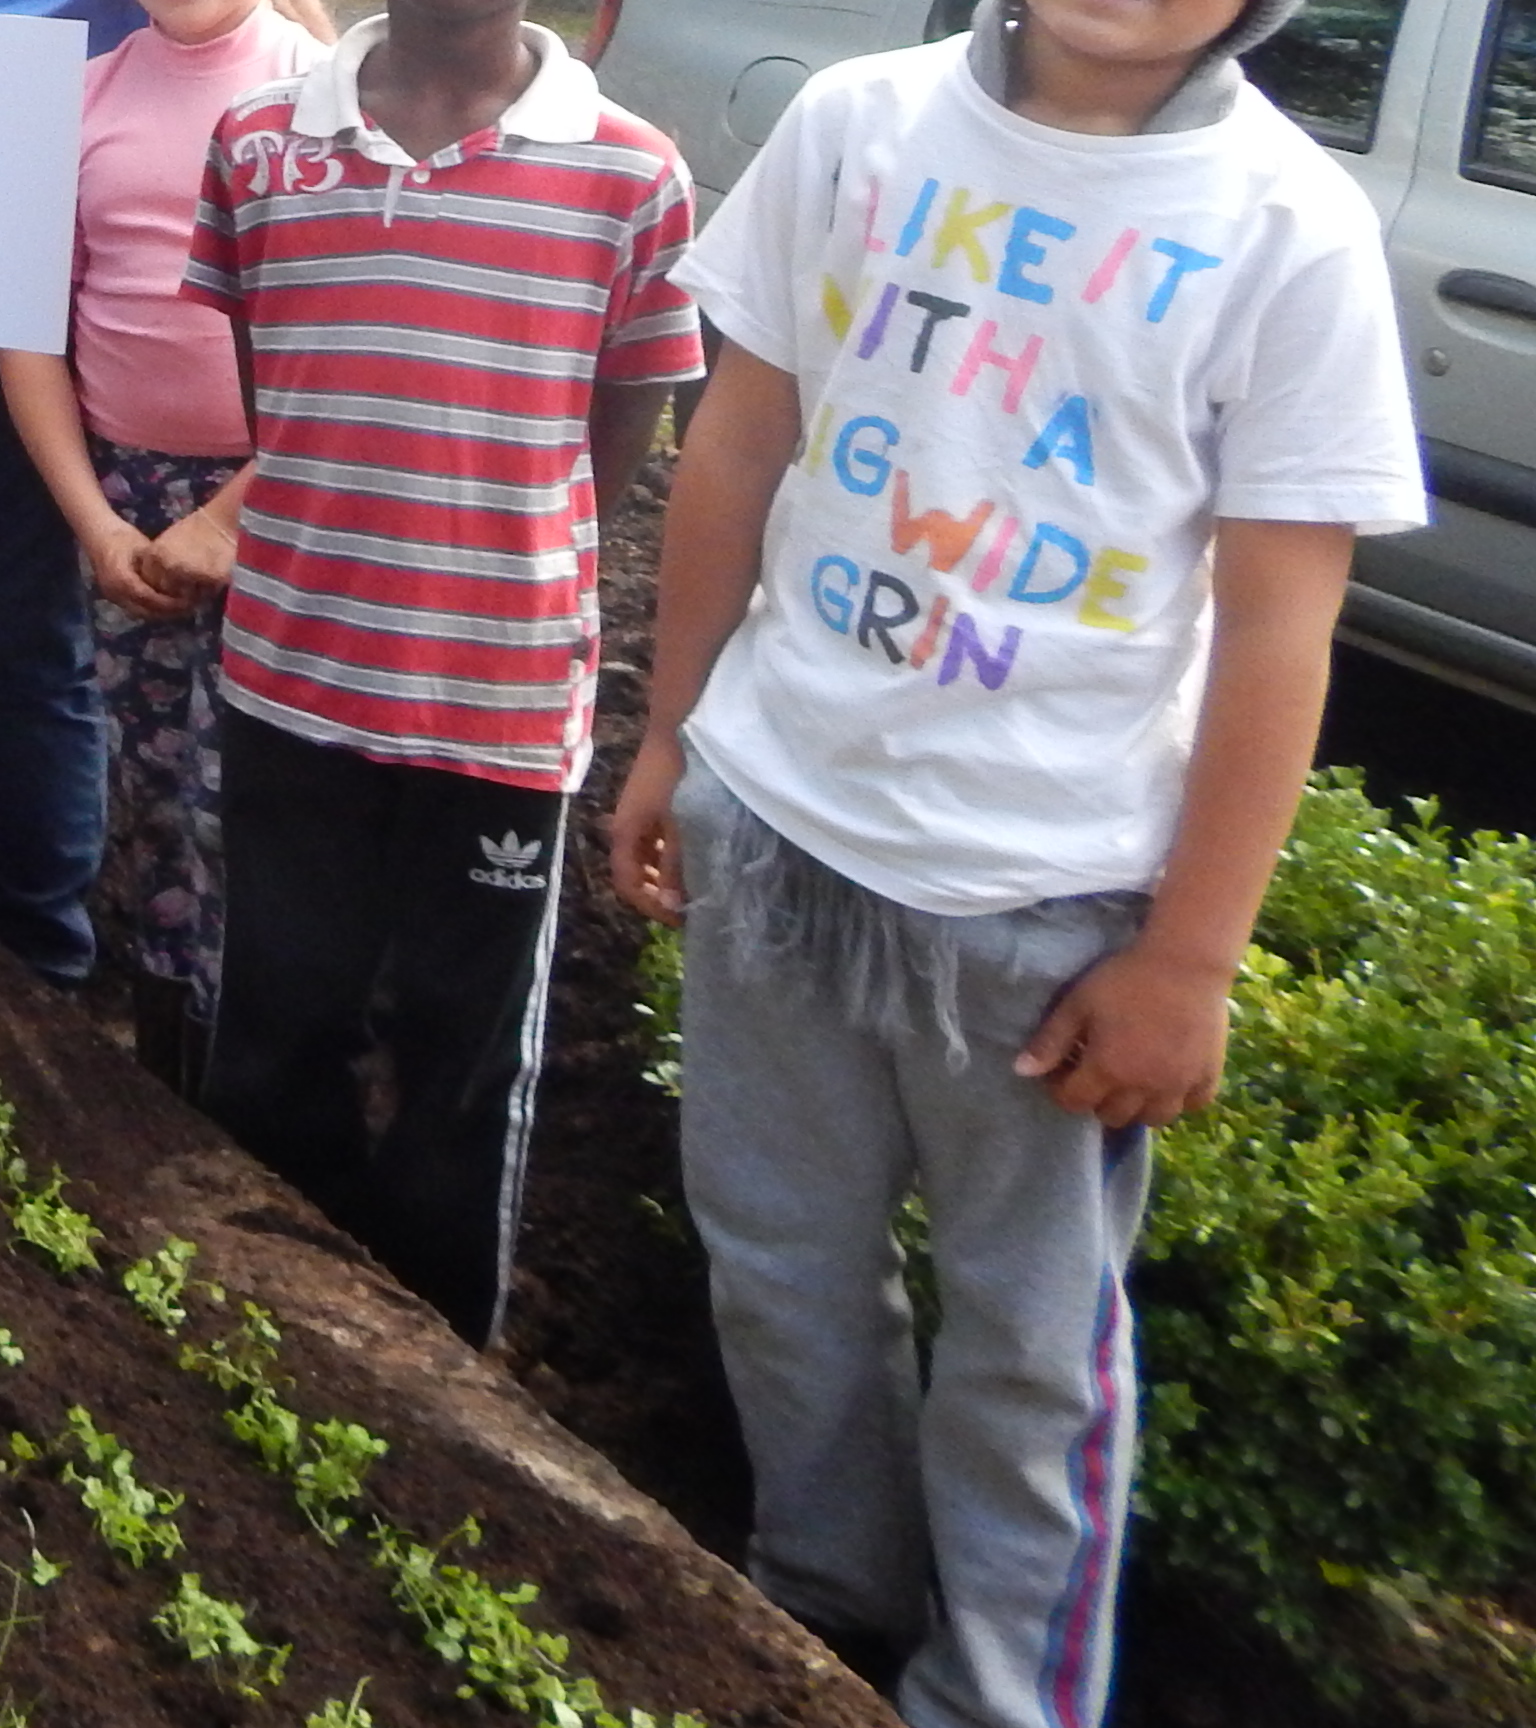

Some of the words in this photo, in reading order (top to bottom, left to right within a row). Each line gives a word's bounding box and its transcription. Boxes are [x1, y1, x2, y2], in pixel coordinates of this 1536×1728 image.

[864, 173, 1077, 304] LIKE
[1080, 227, 1224, 324] IT
[1021, 394, 1096, 487] A
[890, 469, 1148, 633] WIDE
[810, 553, 1024, 691] GRIN
[468, 868, 547, 891] adidas
